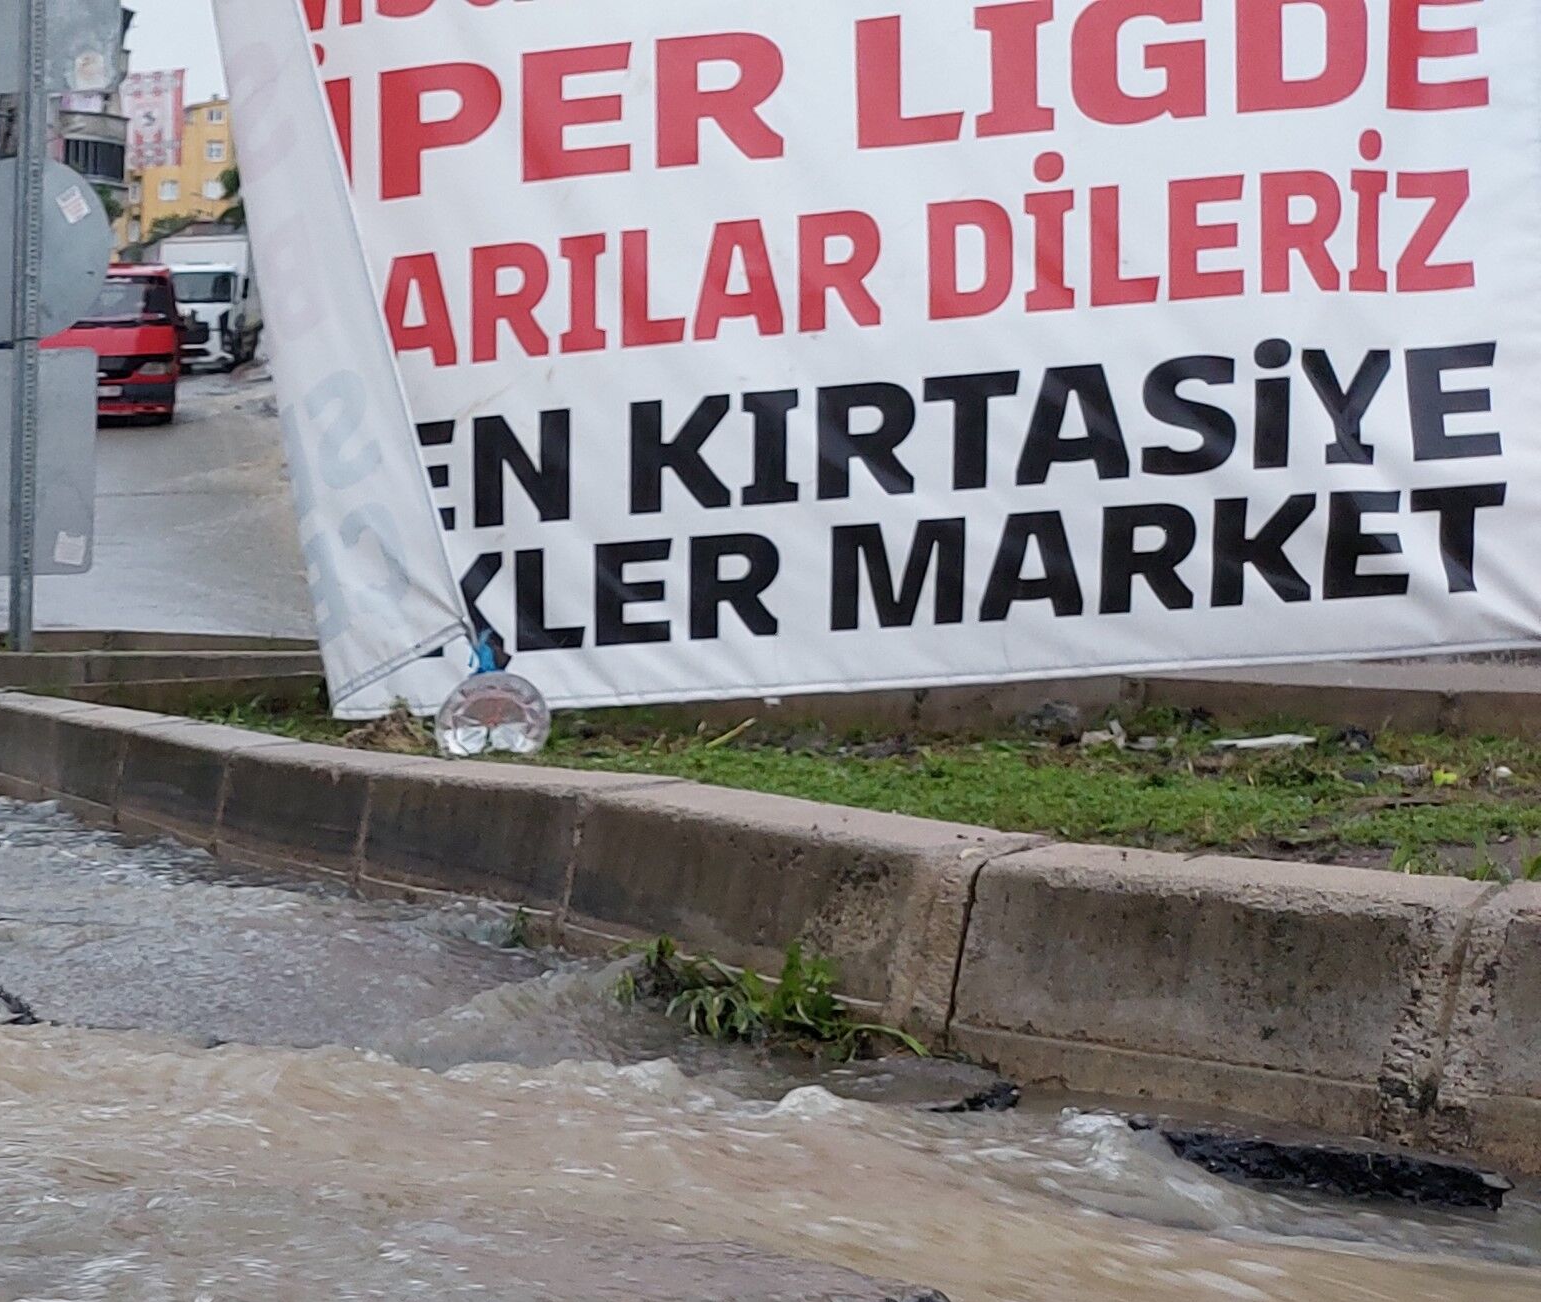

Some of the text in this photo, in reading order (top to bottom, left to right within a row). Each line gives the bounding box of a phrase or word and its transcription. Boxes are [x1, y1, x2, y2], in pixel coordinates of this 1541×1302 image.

[384, 129, 1475, 367] ARILAR DİLERİZ
[831, 483, 1506, 630] MARKET
